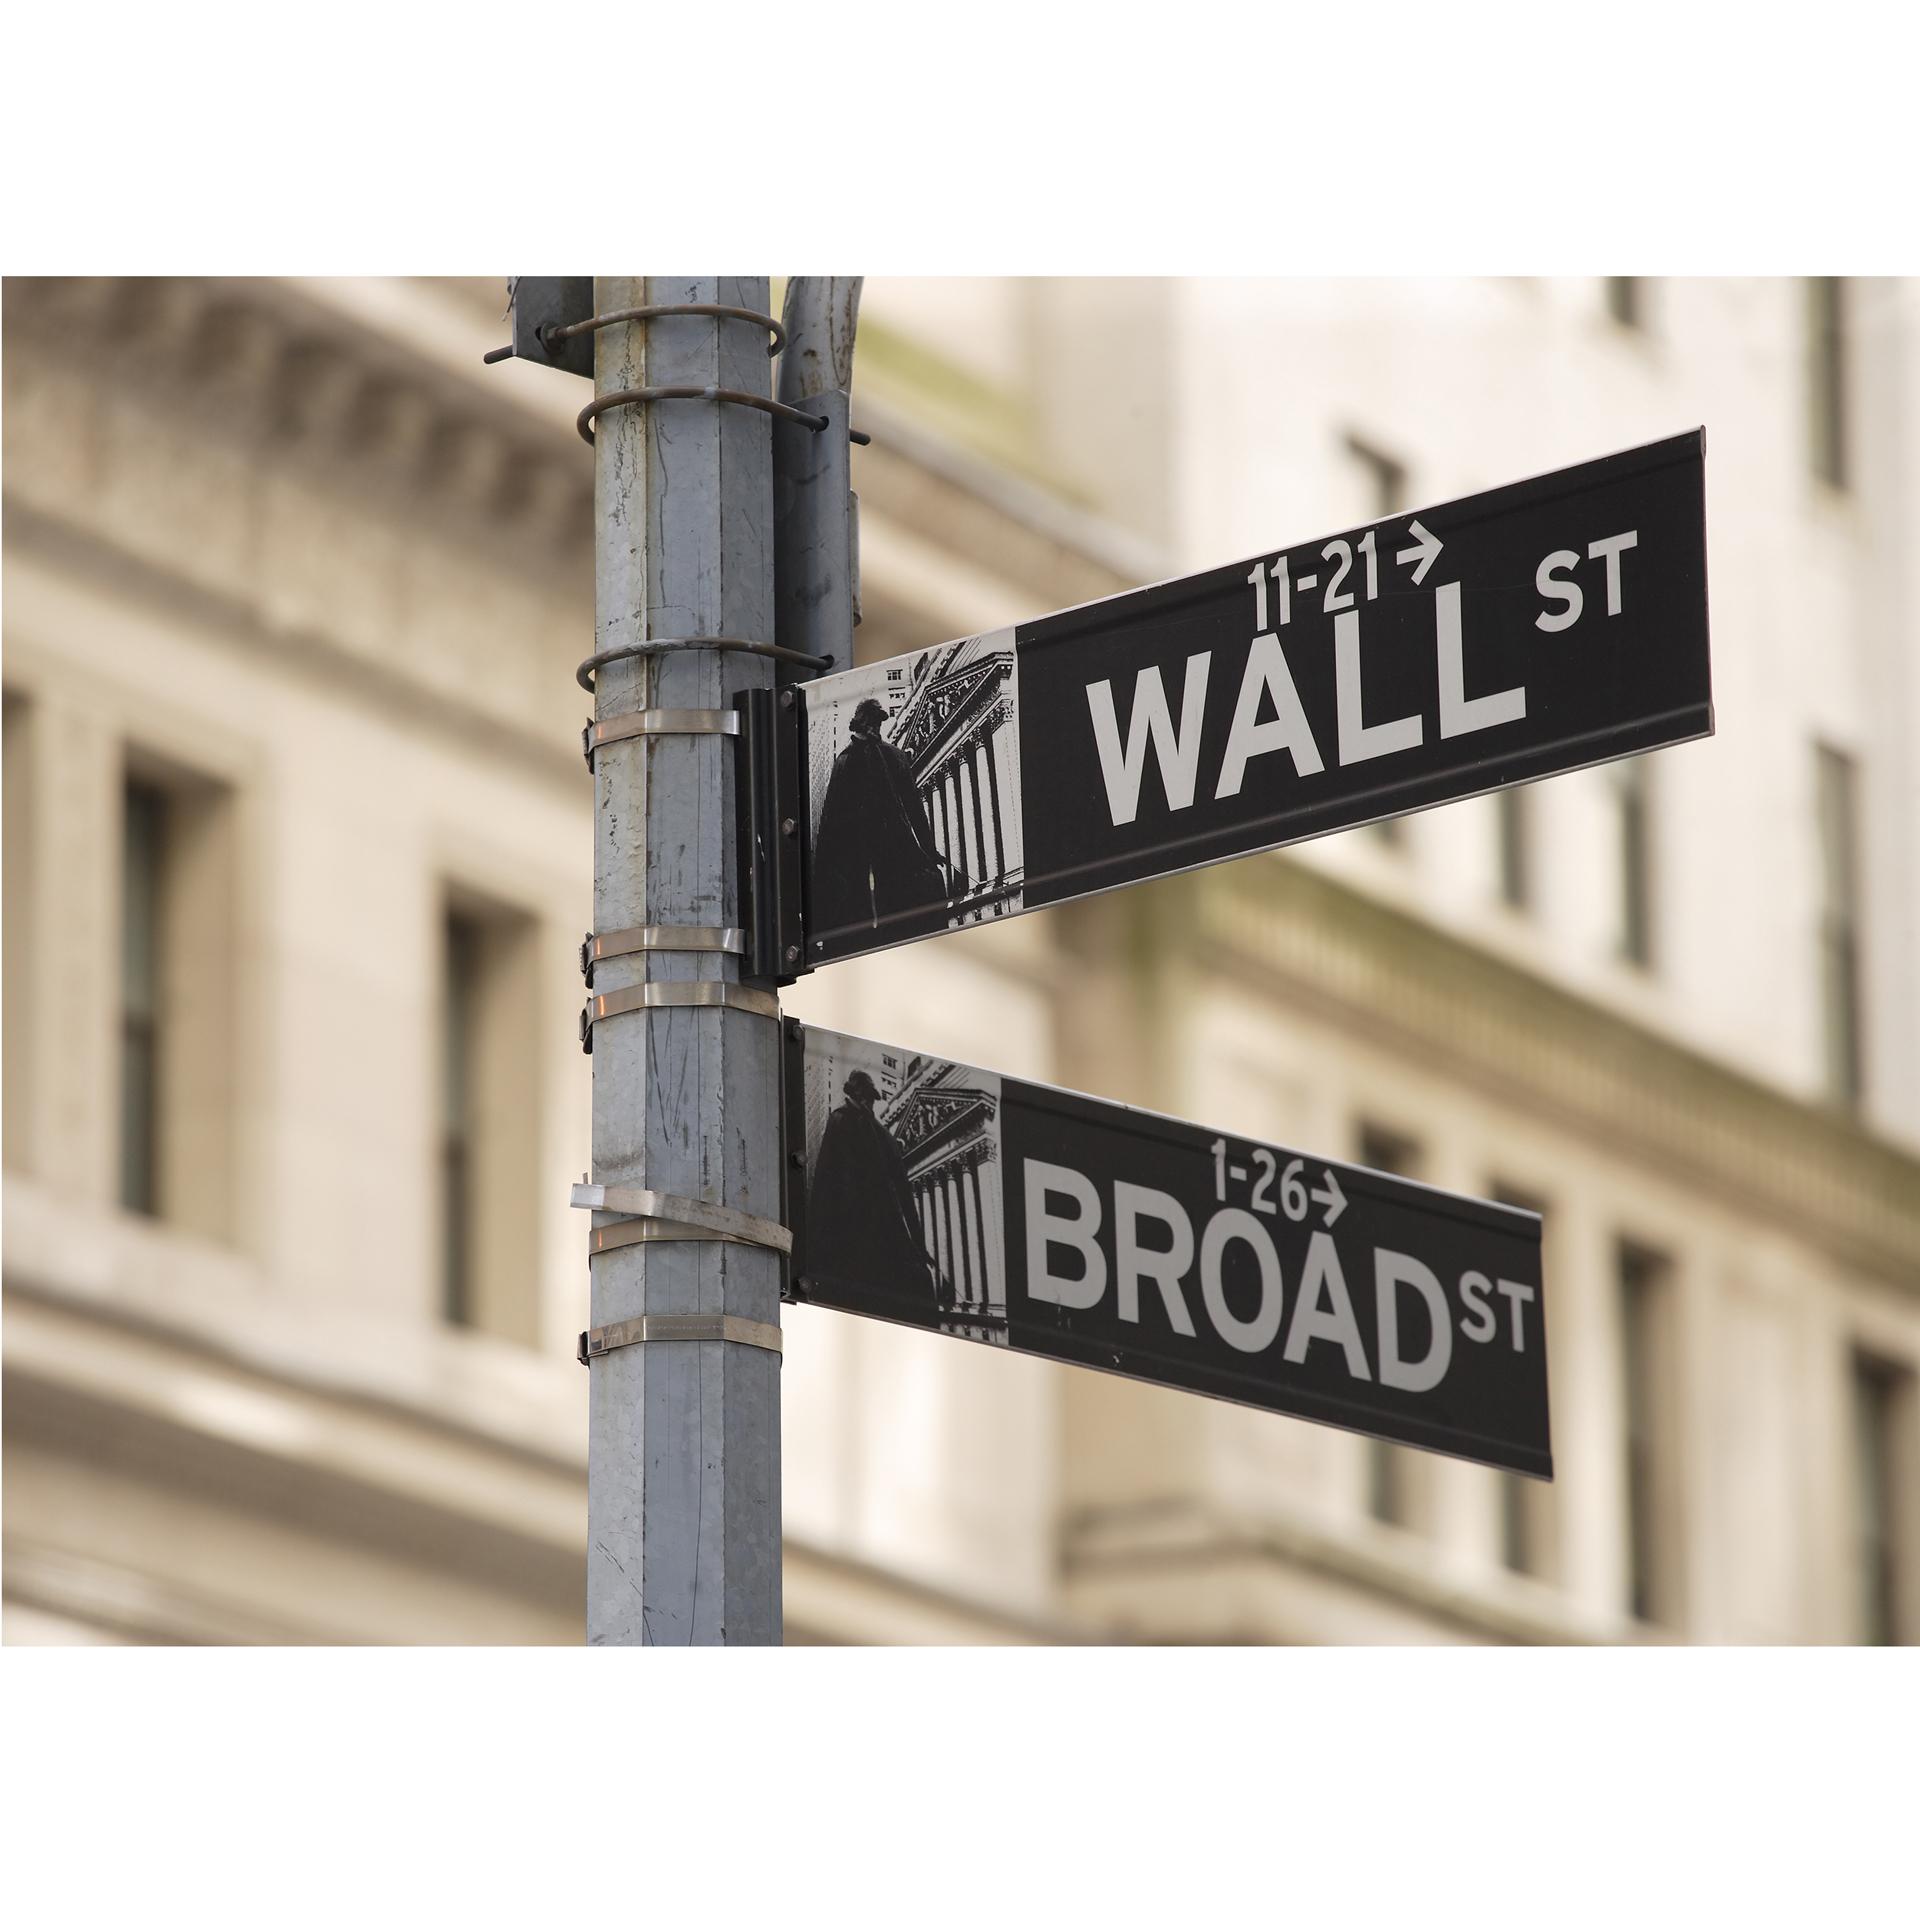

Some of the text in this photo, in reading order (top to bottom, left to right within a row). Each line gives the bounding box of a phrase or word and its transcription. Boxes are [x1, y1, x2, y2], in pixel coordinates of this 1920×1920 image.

[1085, 529, 1638, 827] WALL ST
[1023, 1157, 1535, 1393] BROAD ST
[1211, 1138, 1308, 1222] 1-26
